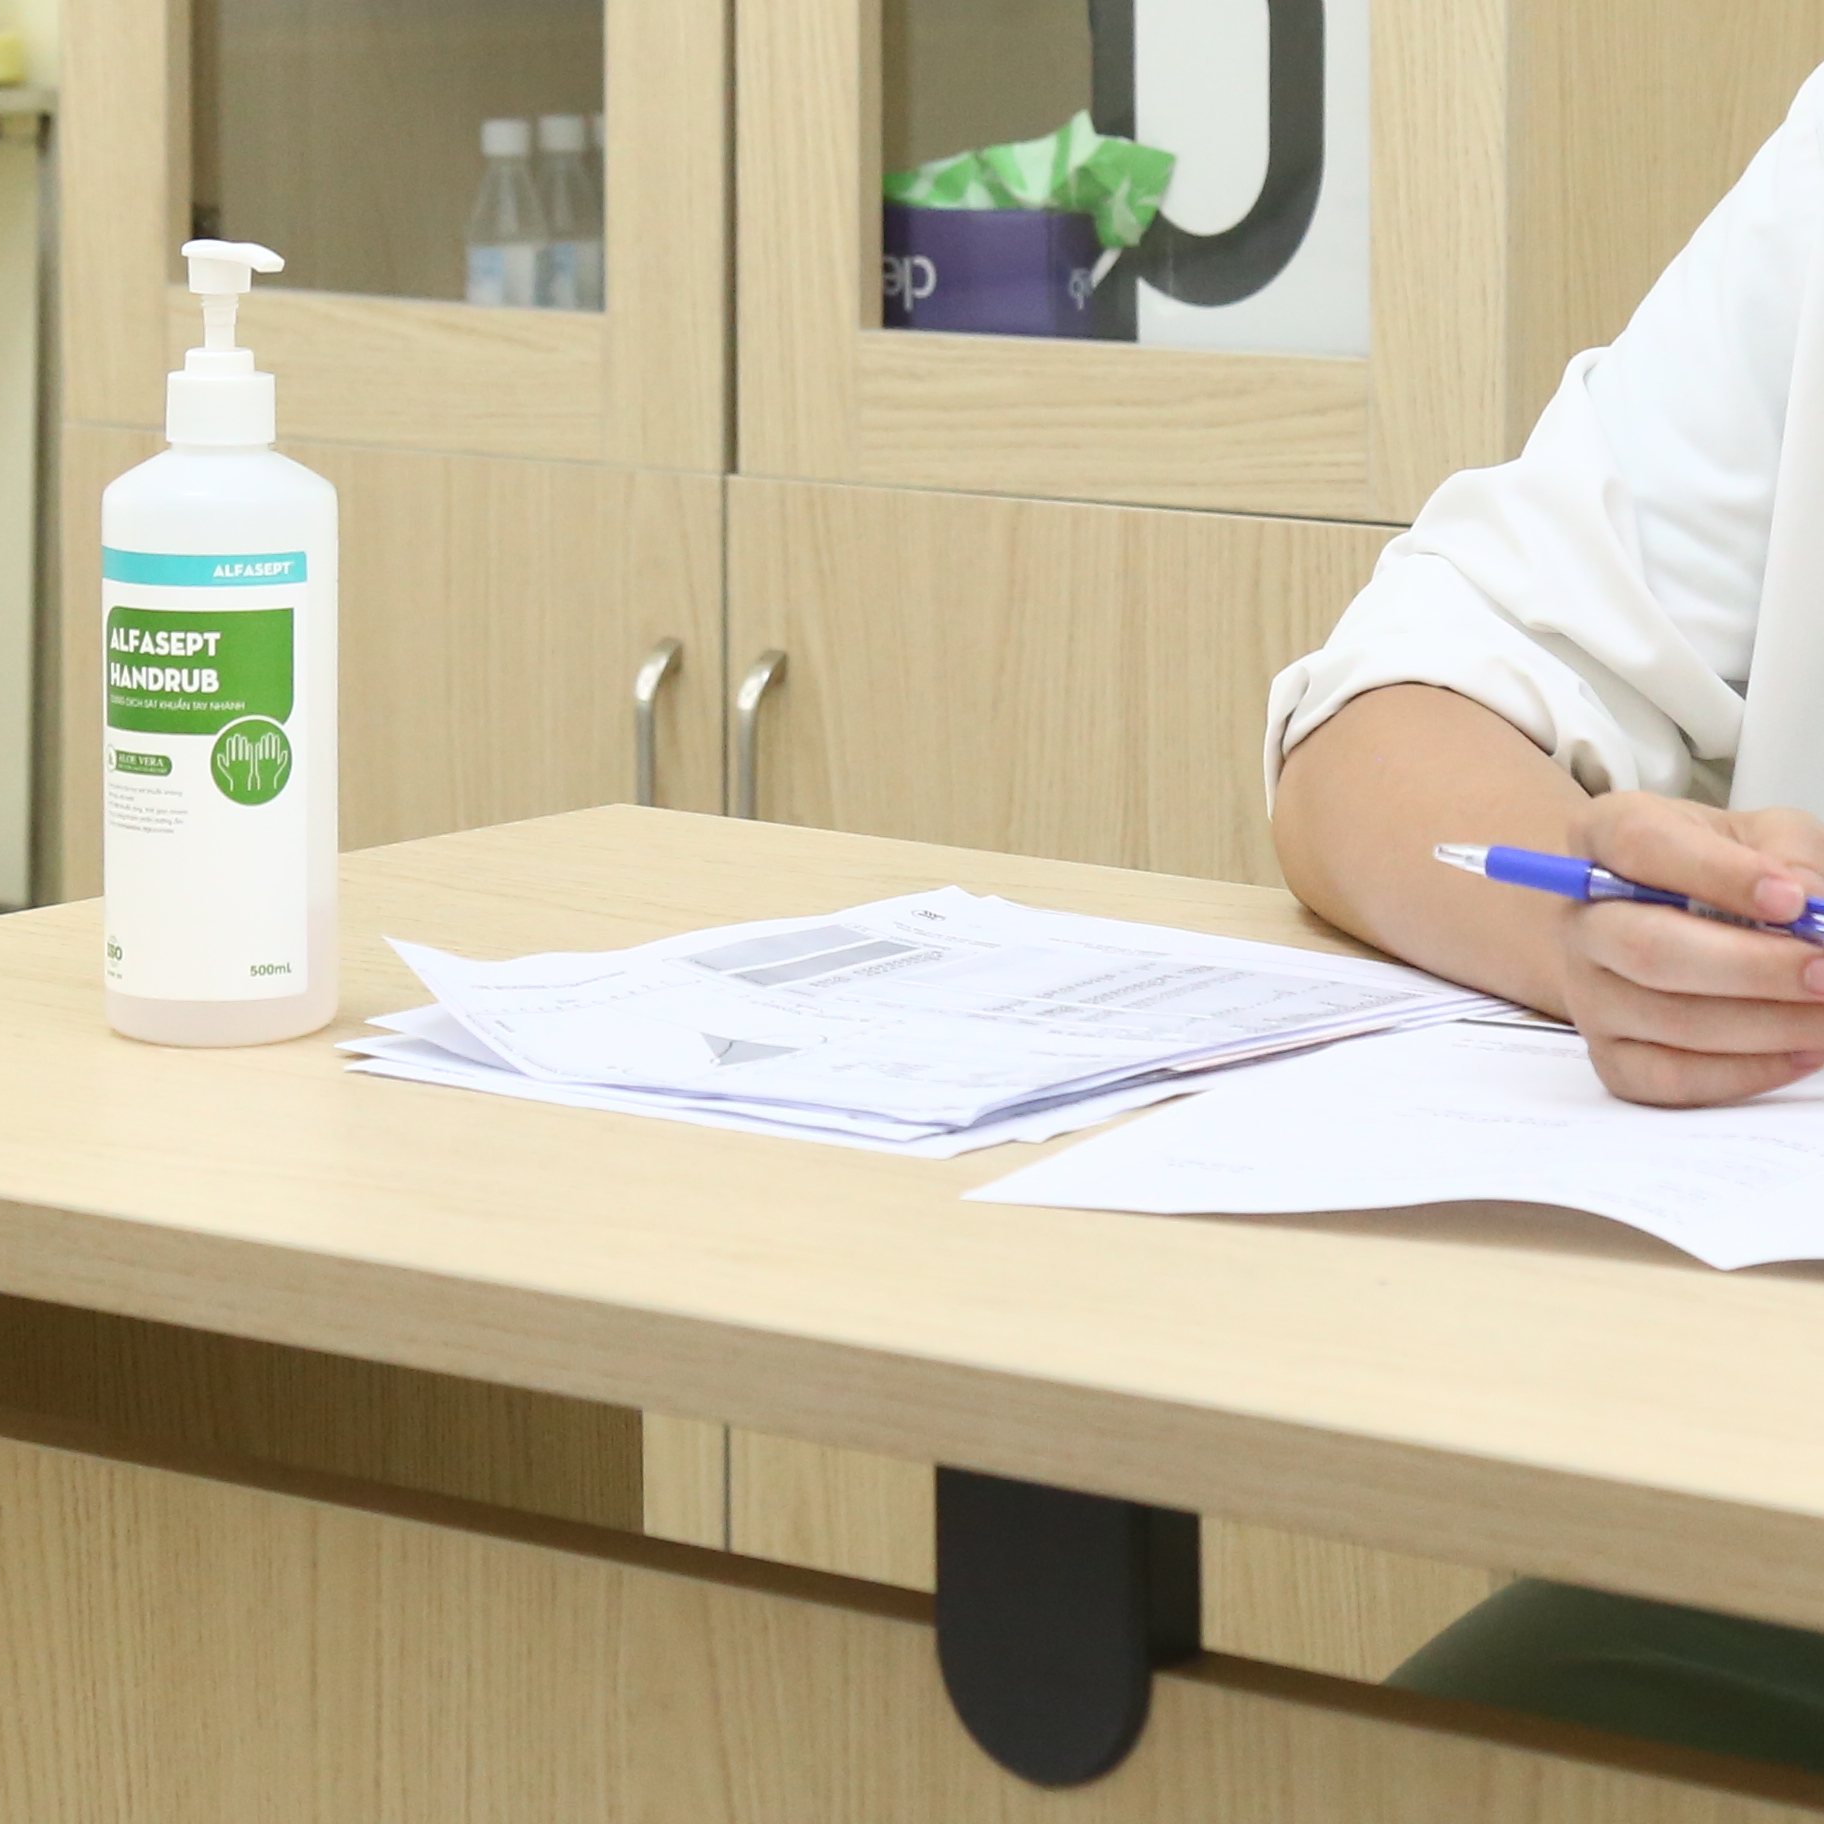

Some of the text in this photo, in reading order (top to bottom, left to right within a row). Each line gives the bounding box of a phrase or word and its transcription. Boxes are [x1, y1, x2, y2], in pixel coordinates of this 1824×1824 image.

[213, 561, 293, 578] ALFASEPT
[110, 627, 221, 657] ALFASEPT
[110, 662, 221, 694] HANDRUB
